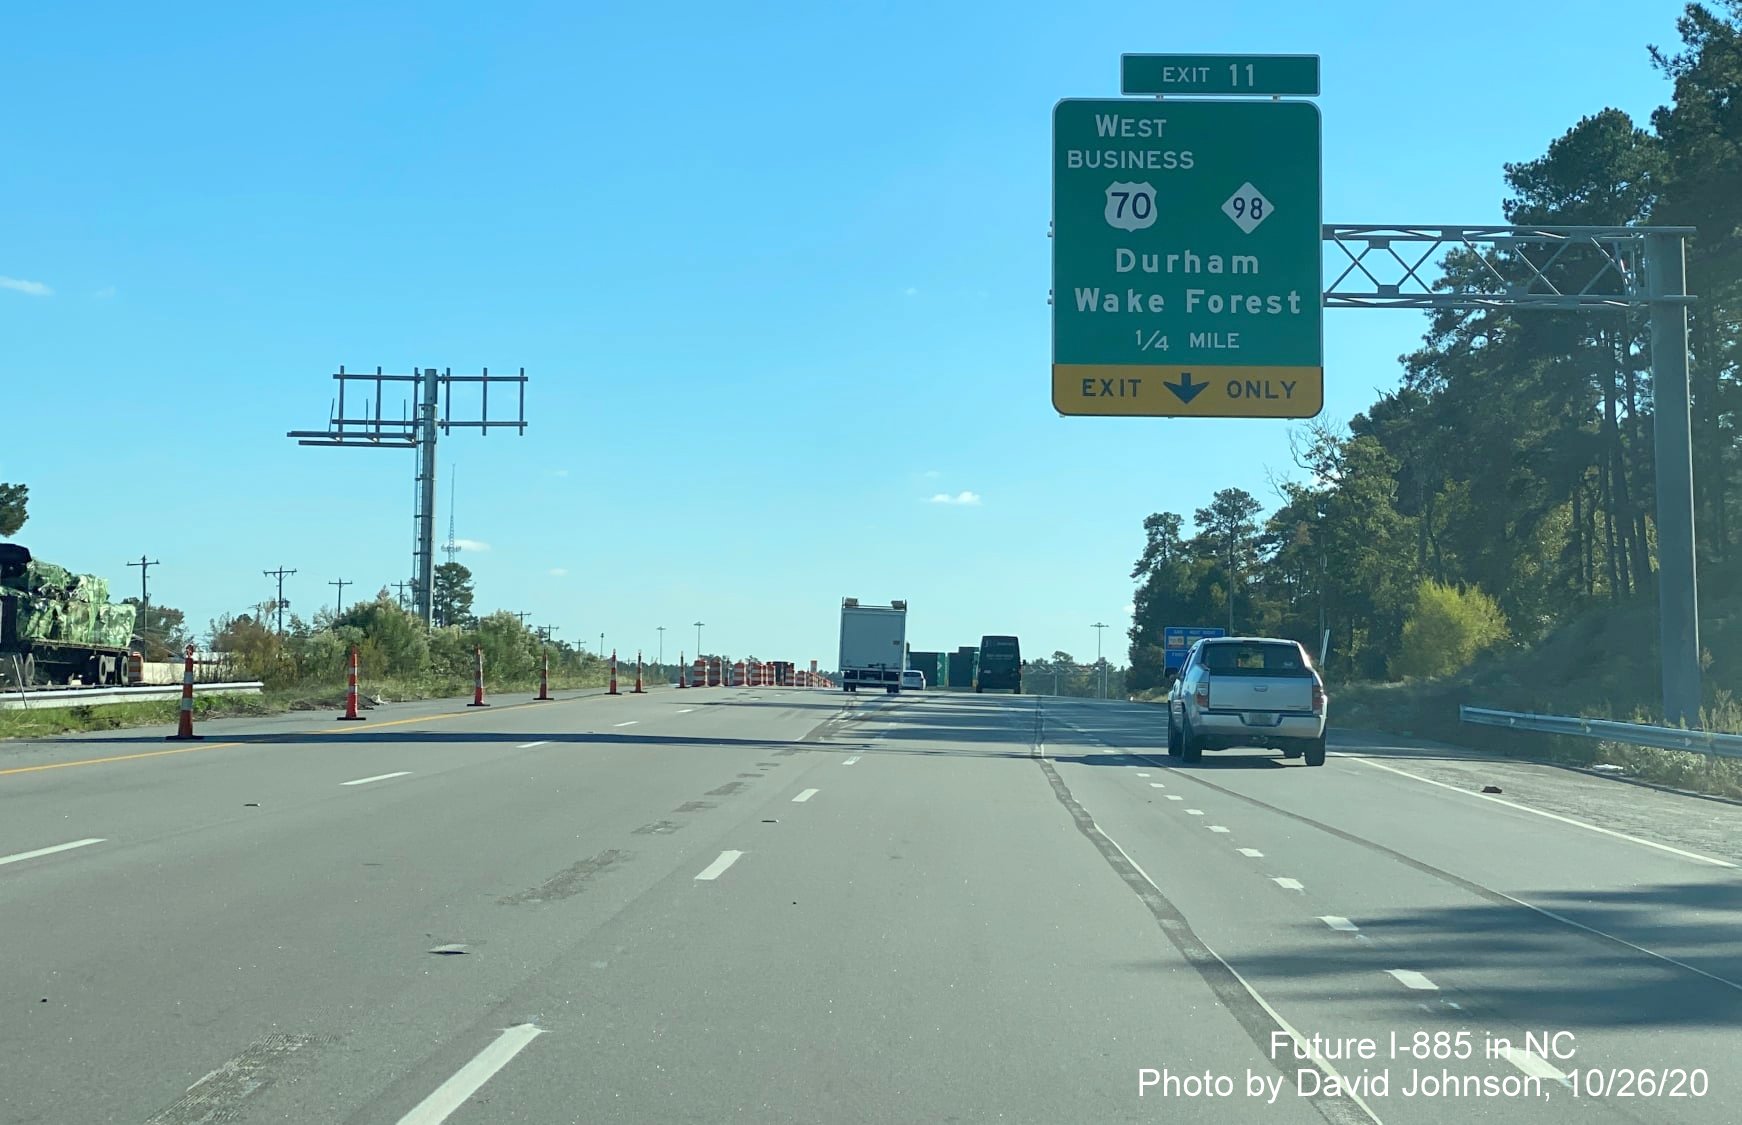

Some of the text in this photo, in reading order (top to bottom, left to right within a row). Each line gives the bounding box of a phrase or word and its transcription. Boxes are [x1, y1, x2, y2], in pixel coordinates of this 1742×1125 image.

[1163, 64, 1254, 87] EXIT 11
[1095, 114, 1166, 138] WEST
[1067, 150, 1194, 169] BUSINESS
[1111, 192, 1151, 220] 70
[1232, 197, 1263, 220] 98
[1116, 249, 1259, 274] Durham
[1075, 288, 1301, 314] Wake Forest
[1135, 330, 1240, 352] 1/4 MILE
[1082, 379, 1297, 399] EXIT ONLY
